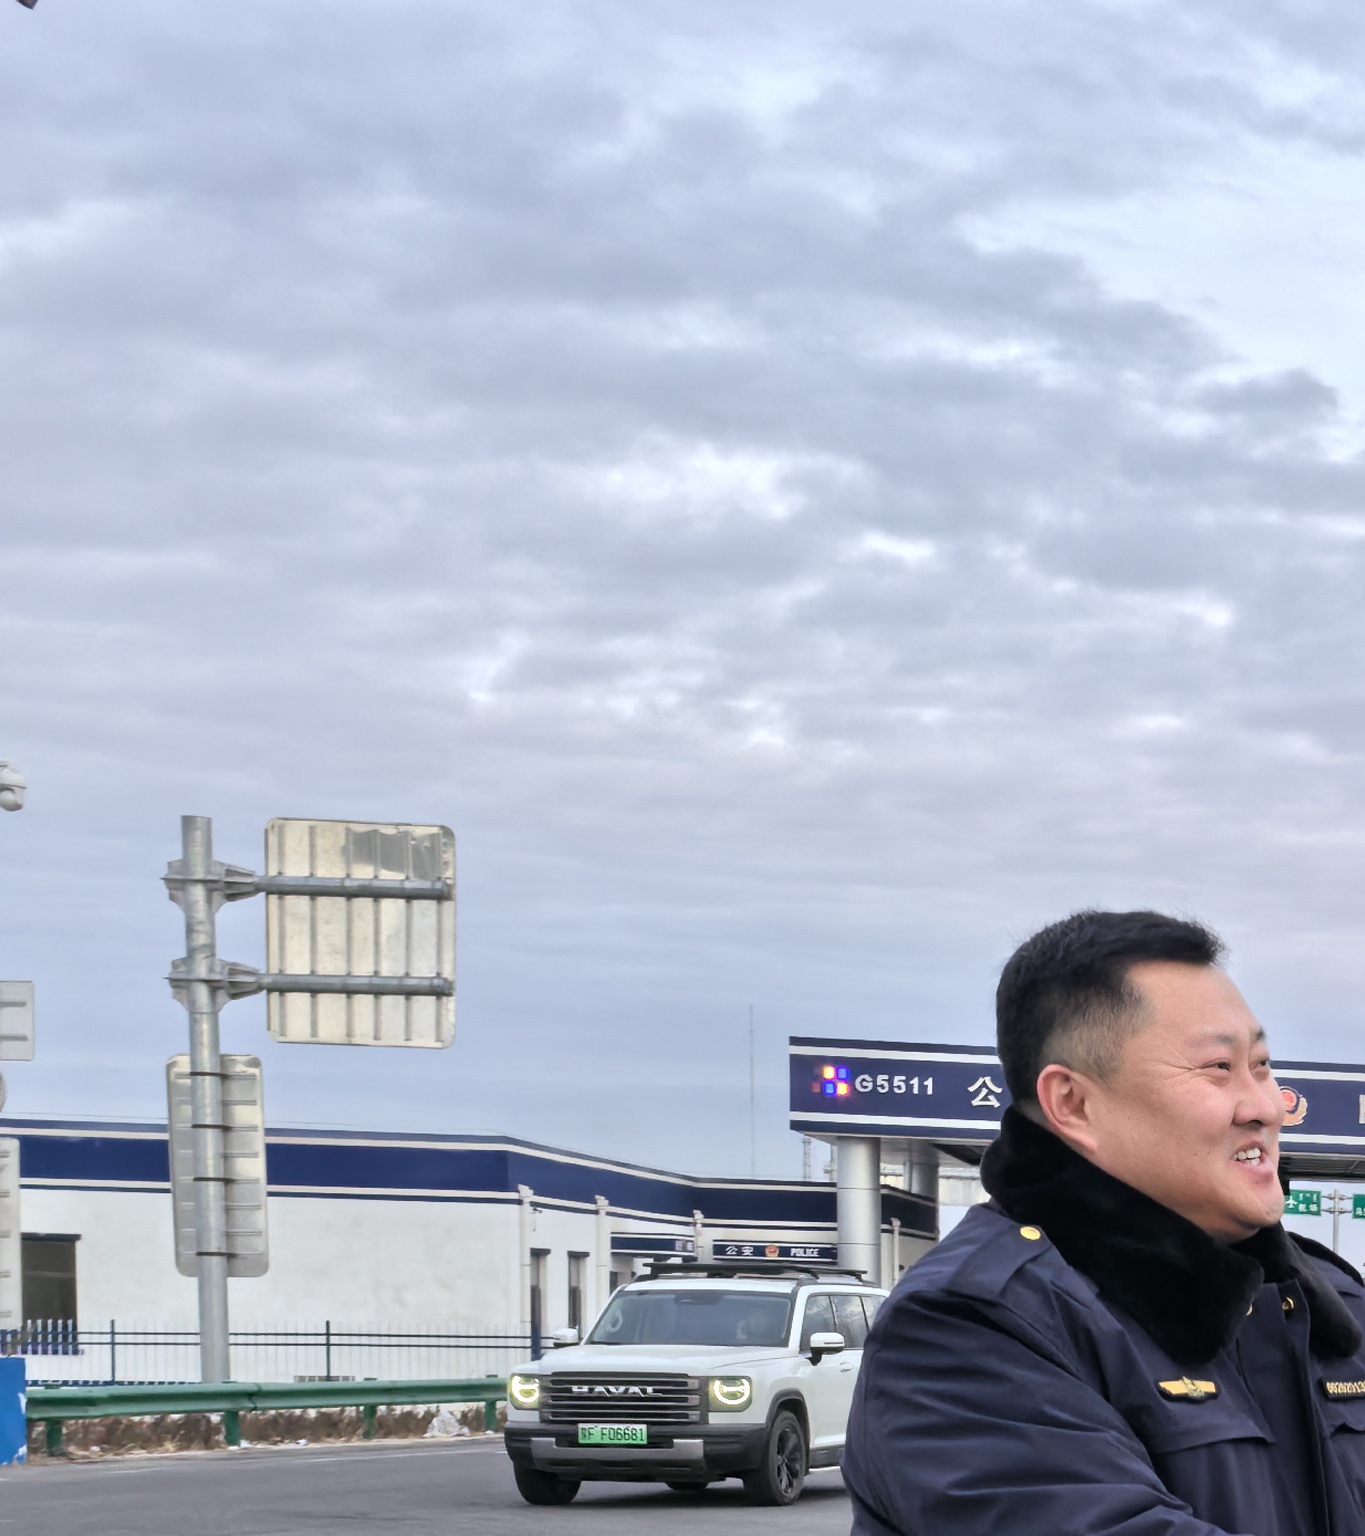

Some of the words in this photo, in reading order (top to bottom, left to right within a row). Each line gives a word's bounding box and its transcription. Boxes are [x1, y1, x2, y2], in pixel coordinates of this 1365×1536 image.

[854, 1073, 934, 1096] G5511
[725, 1245, 754, 1256] 公安
[790, 1247, 820, 1258] POLICE
[571, 1385, 663, 1398] HAVAL
